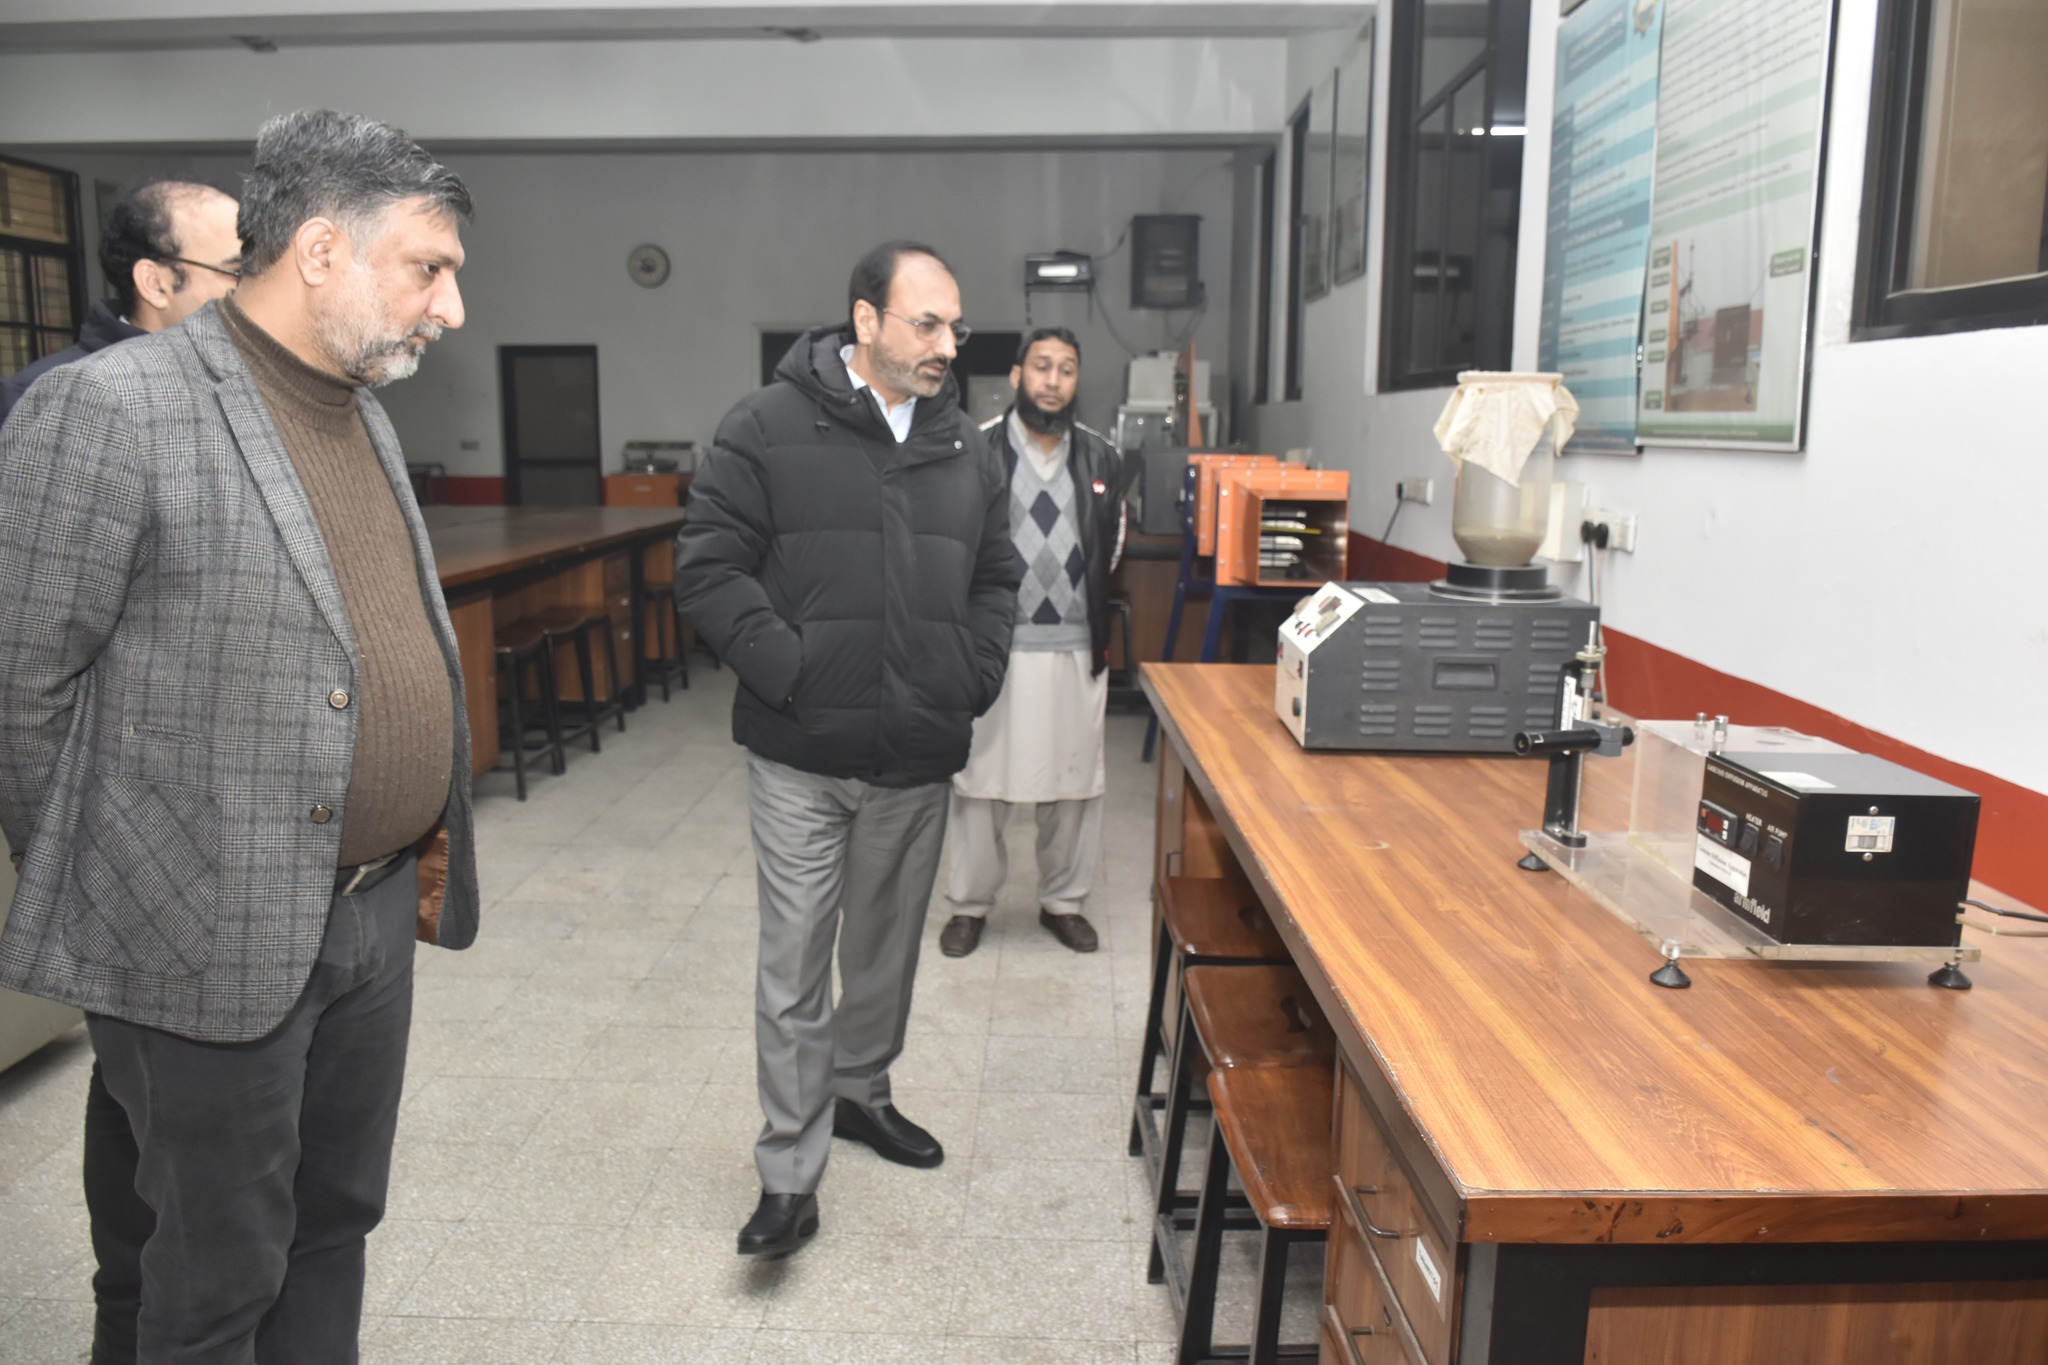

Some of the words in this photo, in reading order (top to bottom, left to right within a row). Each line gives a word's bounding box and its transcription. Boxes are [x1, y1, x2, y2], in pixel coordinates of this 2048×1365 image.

[1724, 771, 1745, 787] DIFFUSION
[1744, 781, 1769, 798] APPARATUS
[1745, 812, 1763, 827] HEATER
[1767, 824, 1775, 834] AIR
[1775, 827, 1788, 839] PUMP
